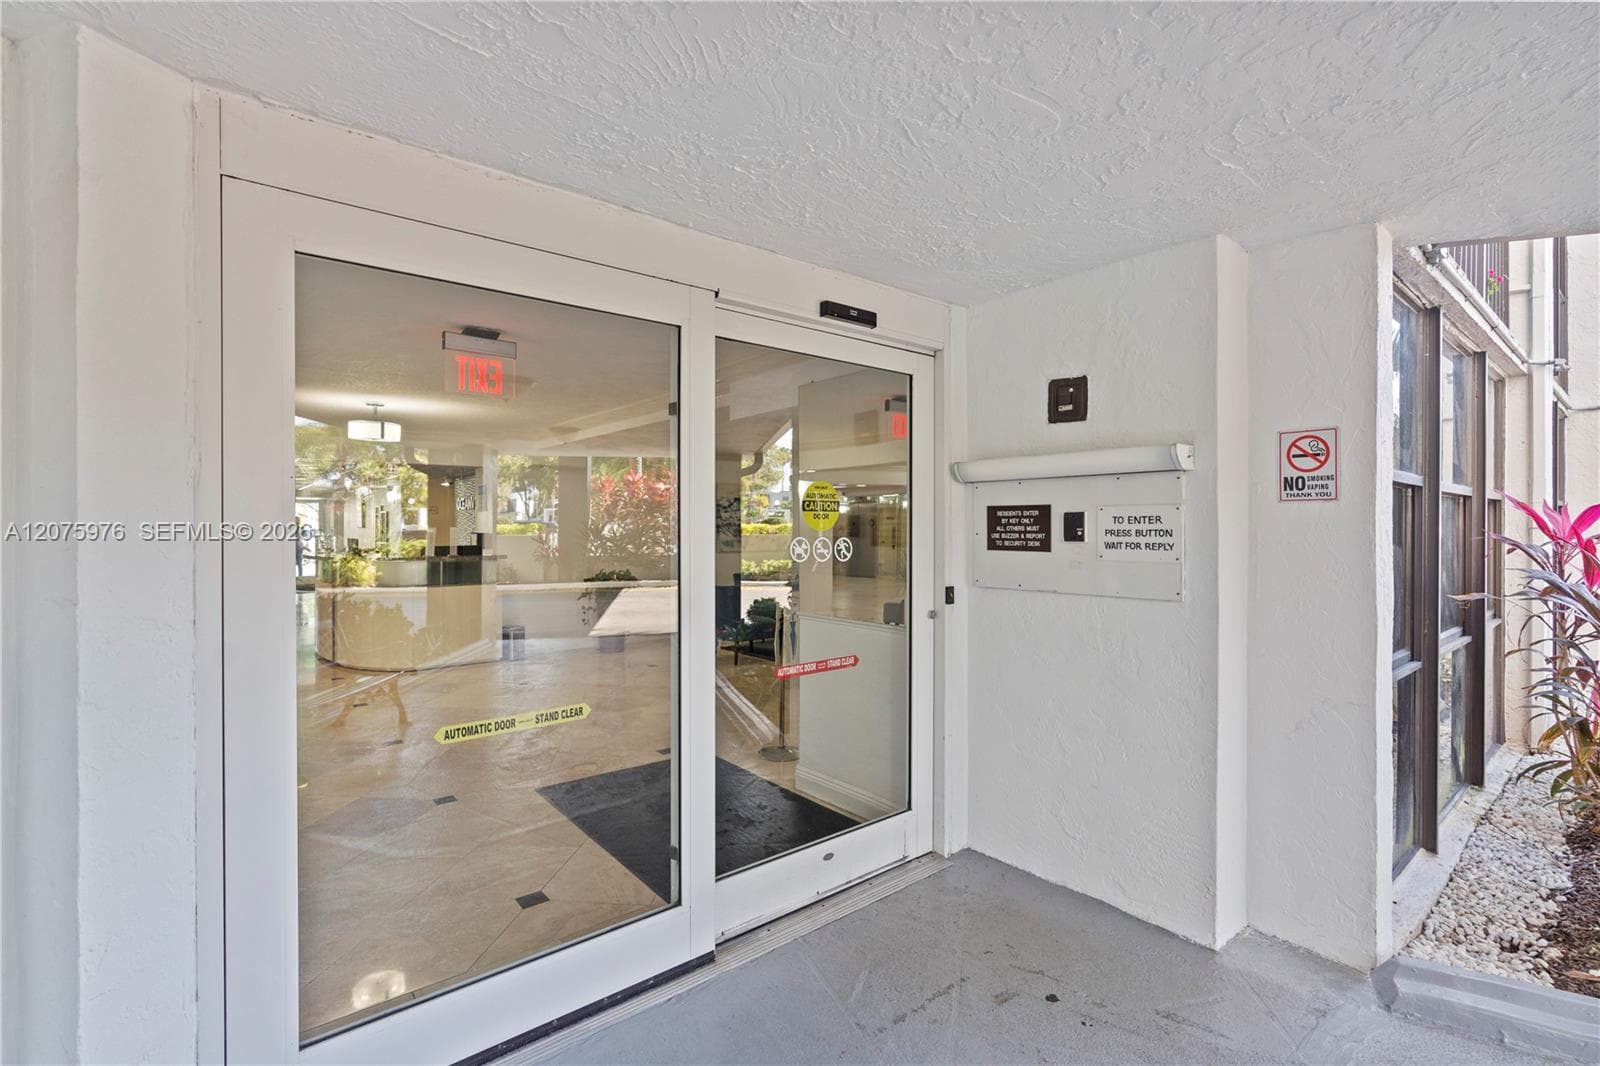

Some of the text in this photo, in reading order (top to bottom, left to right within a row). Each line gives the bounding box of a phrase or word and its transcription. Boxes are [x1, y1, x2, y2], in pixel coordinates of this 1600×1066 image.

[1283, 474, 1335, 492] NO SMOKING
[804, 501, 838, 511] CAUTION
[1112, 515, 1163, 525] TO ENTER
[1104, 529, 1173, 538] PRESS BUTTON
[1104, 541, 1175, 551] WAIT FOR REPLY
[777, 656, 855, 677] AUTOMATIC DOOR STAND CLEAR
[443, 706, 584, 741] AUTOMATIC DOOR STAND CLEAR
